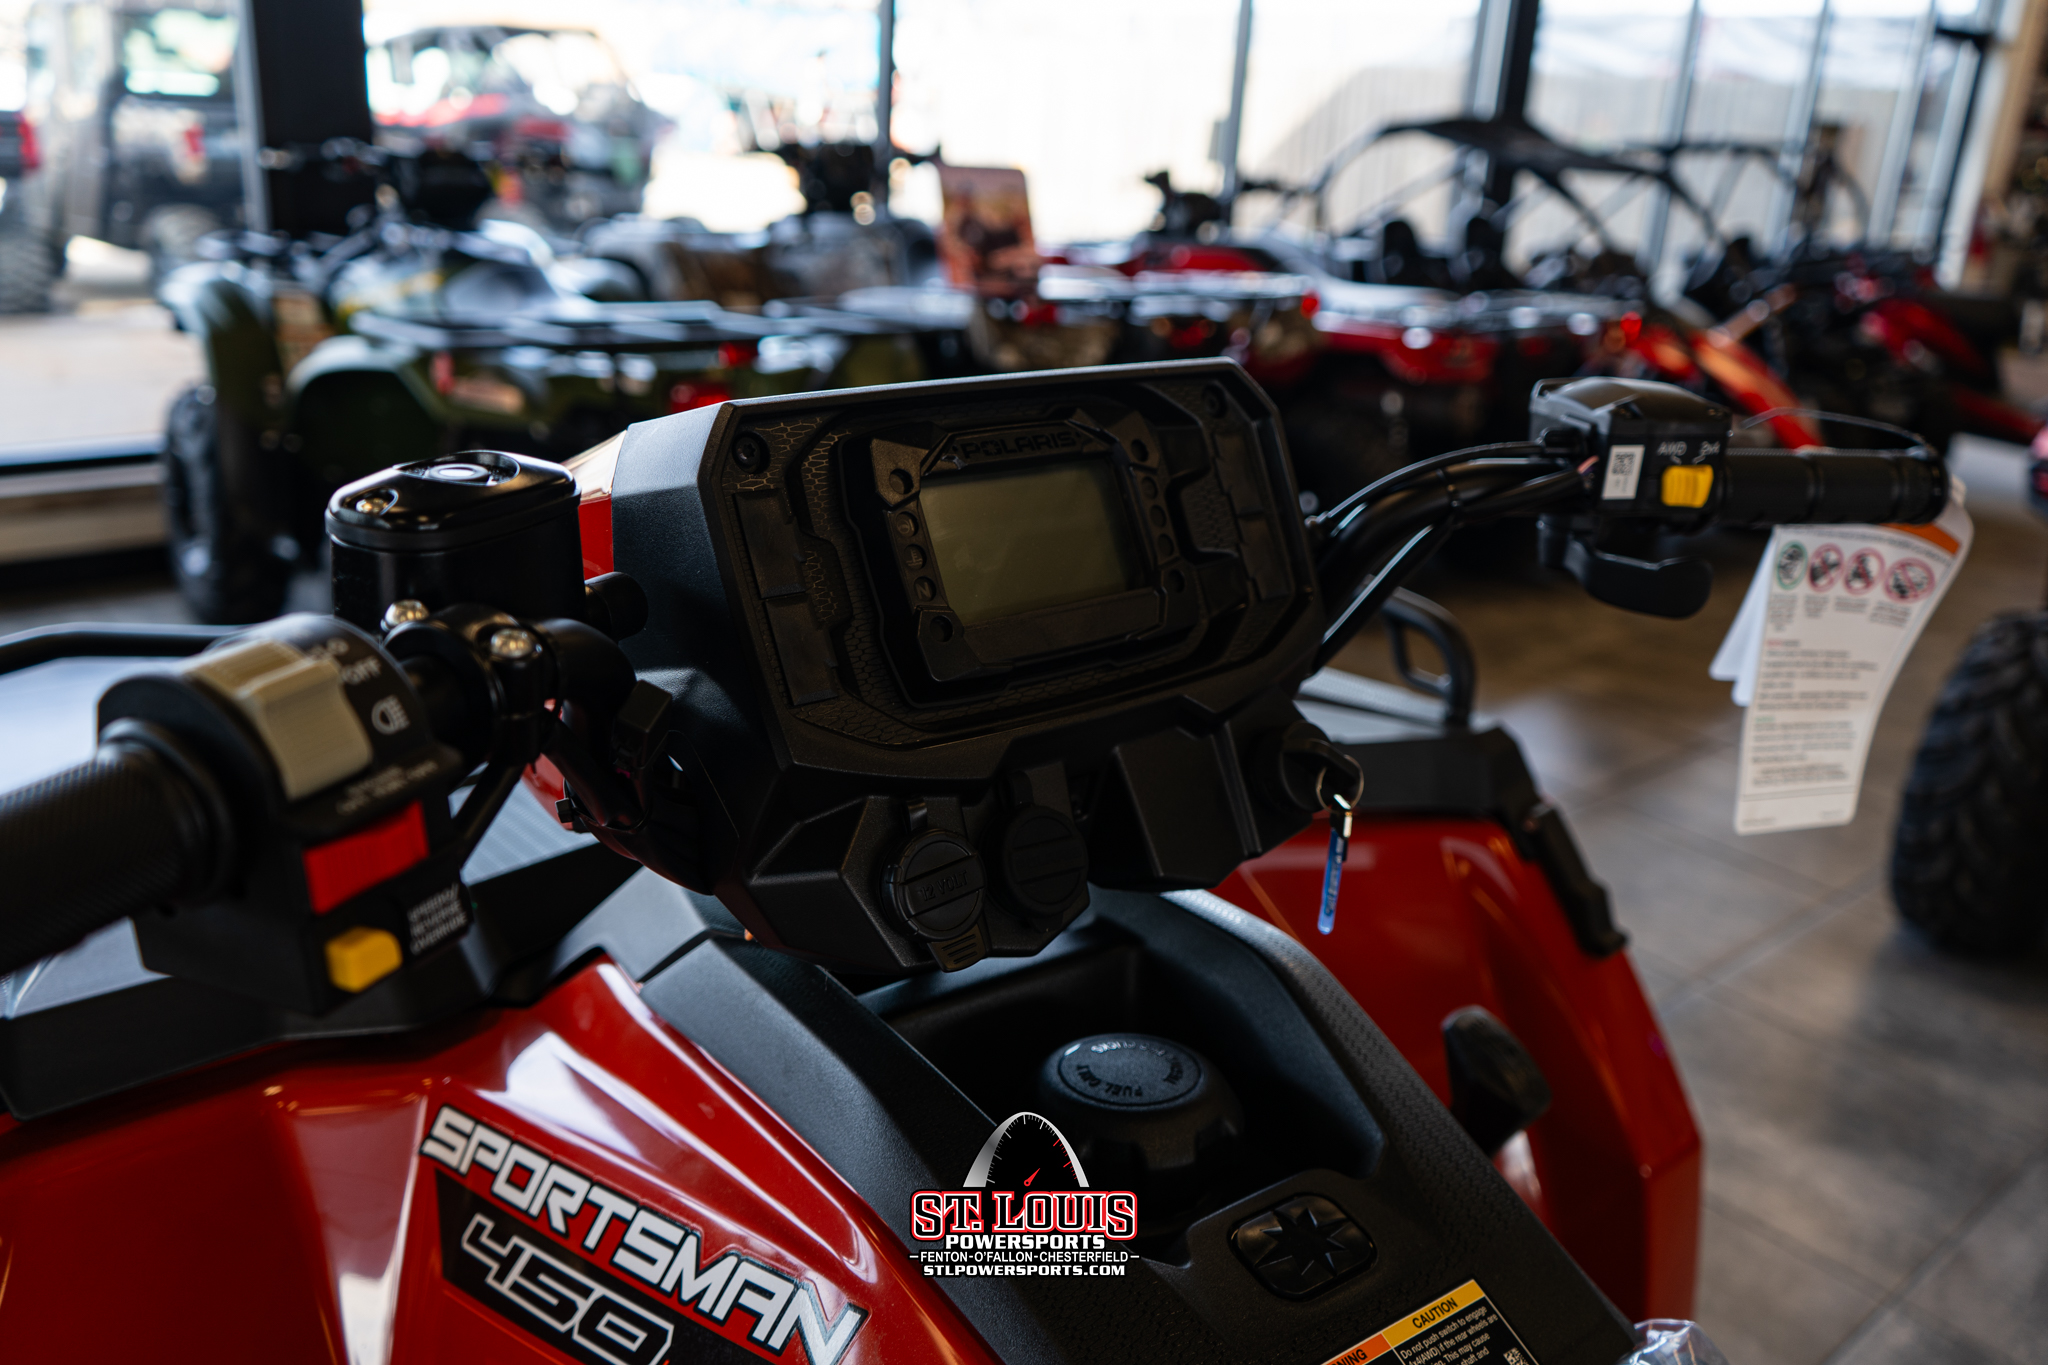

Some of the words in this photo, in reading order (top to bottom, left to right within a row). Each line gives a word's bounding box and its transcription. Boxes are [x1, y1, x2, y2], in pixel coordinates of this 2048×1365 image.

[959, 431, 1077, 459] POLARIS
[1657, 441, 1688, 456] AWD
[919, 884, 936, 902] 12
[937, 869, 969, 895] VOLT
[1104, 1083, 1143, 1098] FUEL
[420, 1104, 869, 1365] SPORTSMAN
[461, 1213, 675, 1365] 450
[1412, 1297, 1459, 1329] CAUTION
[1399, 1349, 1413, 1360] Do
[1411, 1341, 1425, 1353] not
[1422, 1332, 1440, 1348] push
[1438, 1321, 1460, 1338] switch
[1457, 1318, 1467, 1327] to
[1464, 1305, 1488, 1323] engage
[1438, 1342, 1446, 1353] if
[1443, 1338, 1457, 1350] the
[1454, 1330, 1469, 1343] rear
[1466, 1318, 1489, 1336] wheels
[1486, 1313, 1499, 1324] are
[1442, 1350, 1460, 1364] This
[1457, 1342, 1474, 1356] may
[1471, 1332, 1491, 1348] cause
[1475, 1345, 1490, 1360] and
